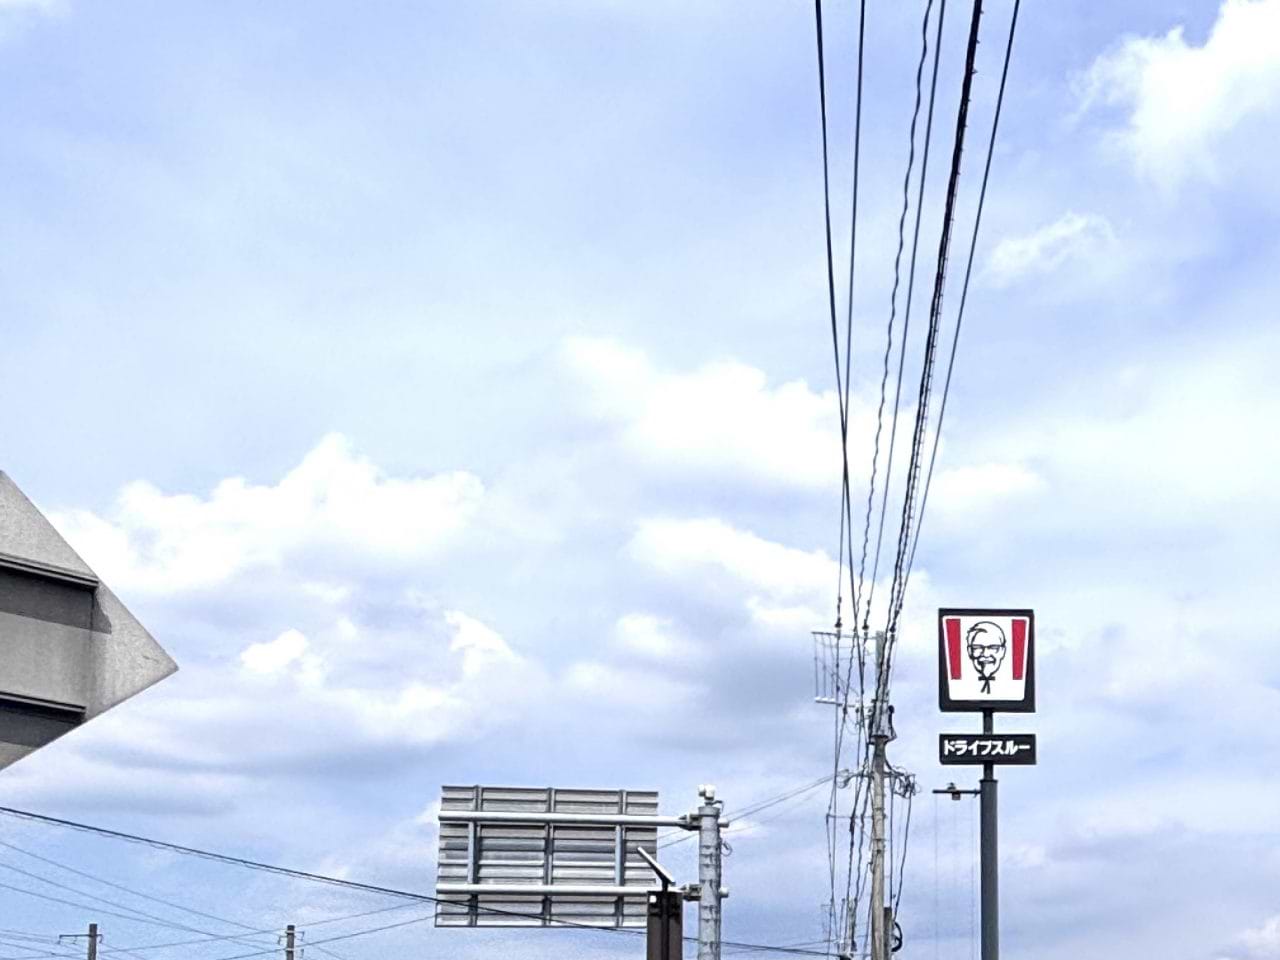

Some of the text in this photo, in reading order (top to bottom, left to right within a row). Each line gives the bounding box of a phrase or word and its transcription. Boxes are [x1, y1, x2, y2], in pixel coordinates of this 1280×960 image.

[943, 739, 1031, 756] ドライブスルー
